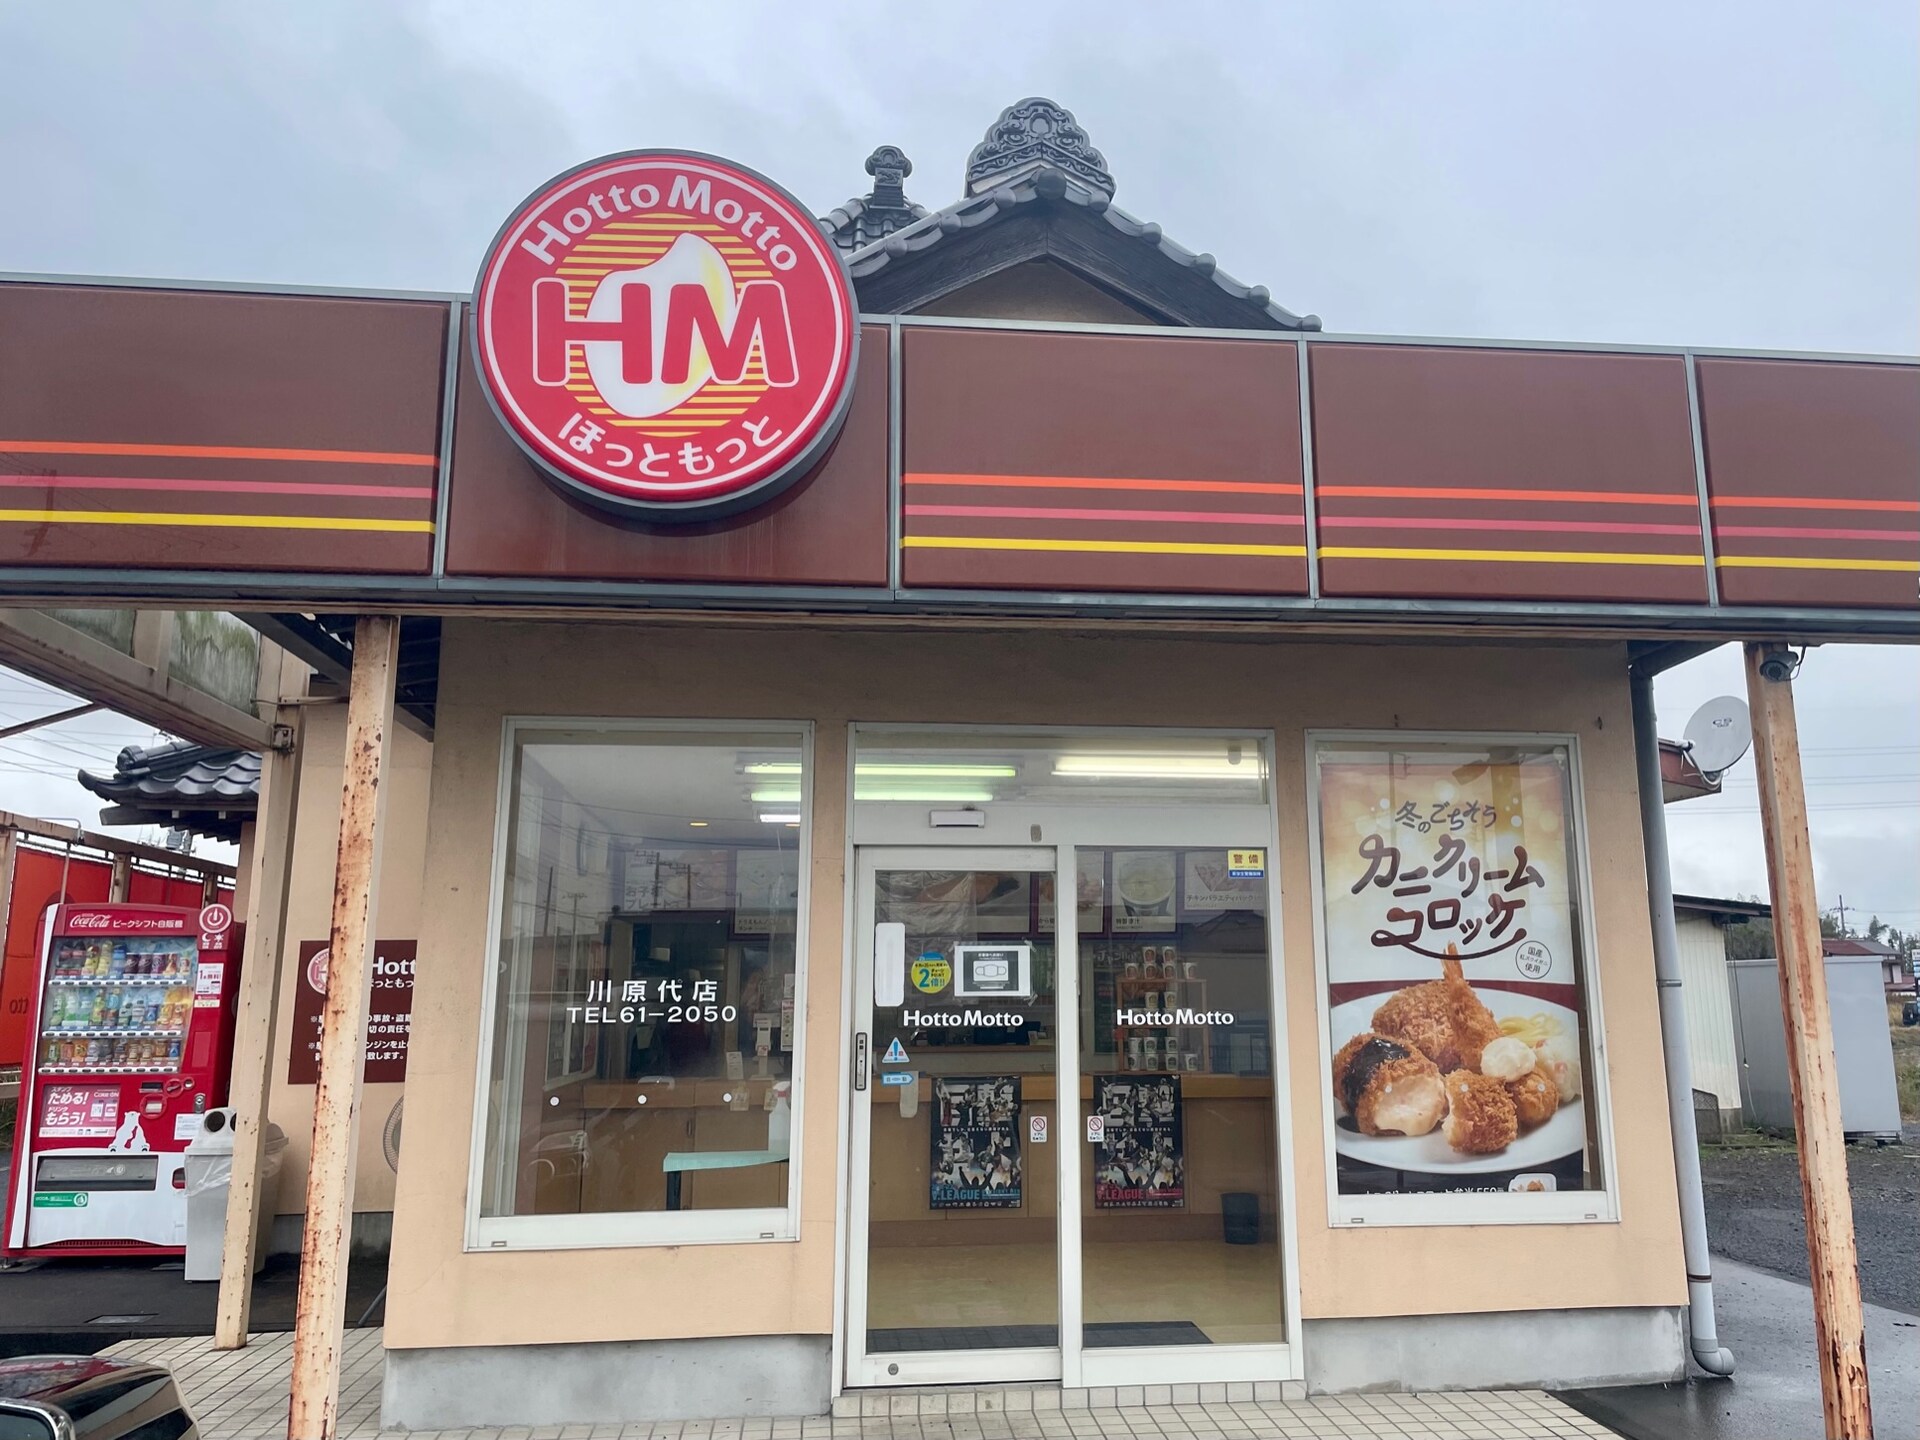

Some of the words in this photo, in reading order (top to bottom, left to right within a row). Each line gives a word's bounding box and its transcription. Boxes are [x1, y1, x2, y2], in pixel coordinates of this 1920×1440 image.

[557, 411, 784, 478] ほっともっと
[1394, 799, 1498, 834] 冬のごちそう
[1351, 833, 1546, 899] カニクリーム
[1371, 892, 1527, 952] コロッケ
[1527, 946, 1543, 958] 国産
[587, 979, 718, 1003] 川原代店
[47, 1092, 89, 1104] ためる!
[45, 1112, 86, 1125] もらう!
